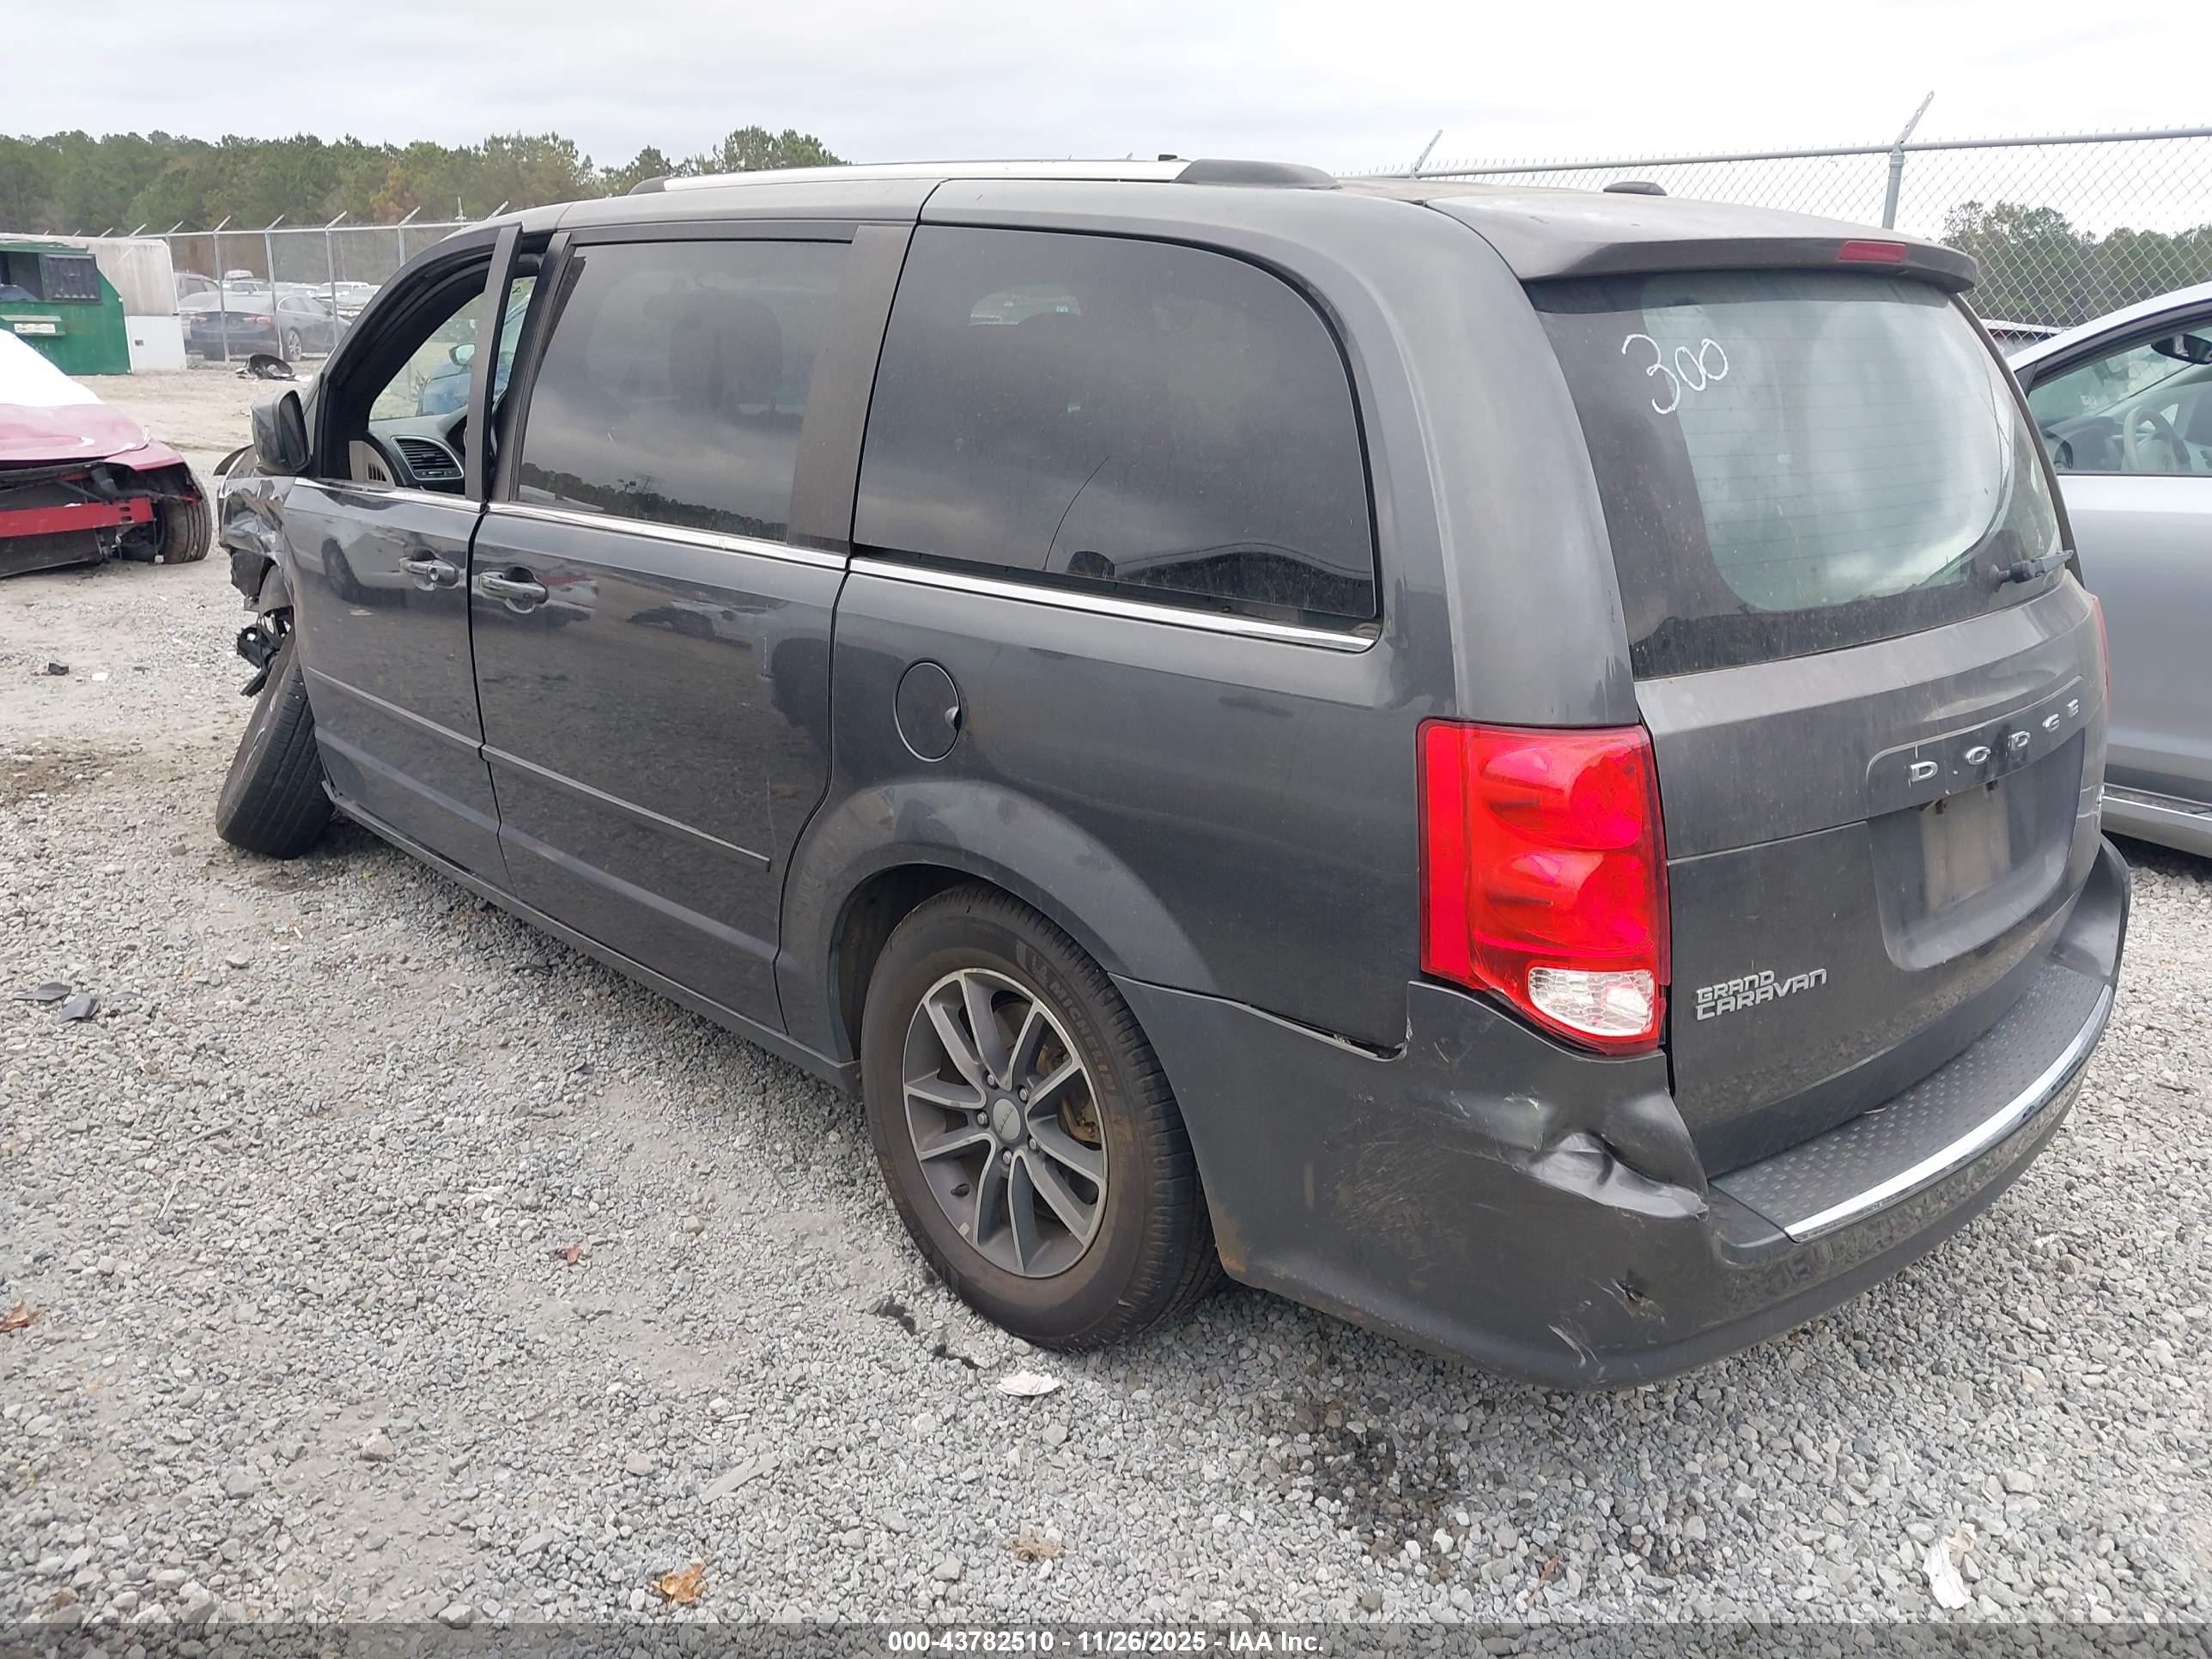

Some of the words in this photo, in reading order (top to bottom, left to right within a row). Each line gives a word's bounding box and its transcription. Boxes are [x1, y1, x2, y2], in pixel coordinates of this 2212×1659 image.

[1621, 334, 1729, 415] 300
[1910, 698, 2080, 782] DODGE
[1695, 968, 1827, 1022] CARAVAN
[1696, 970, 1775, 1004] GRAND
